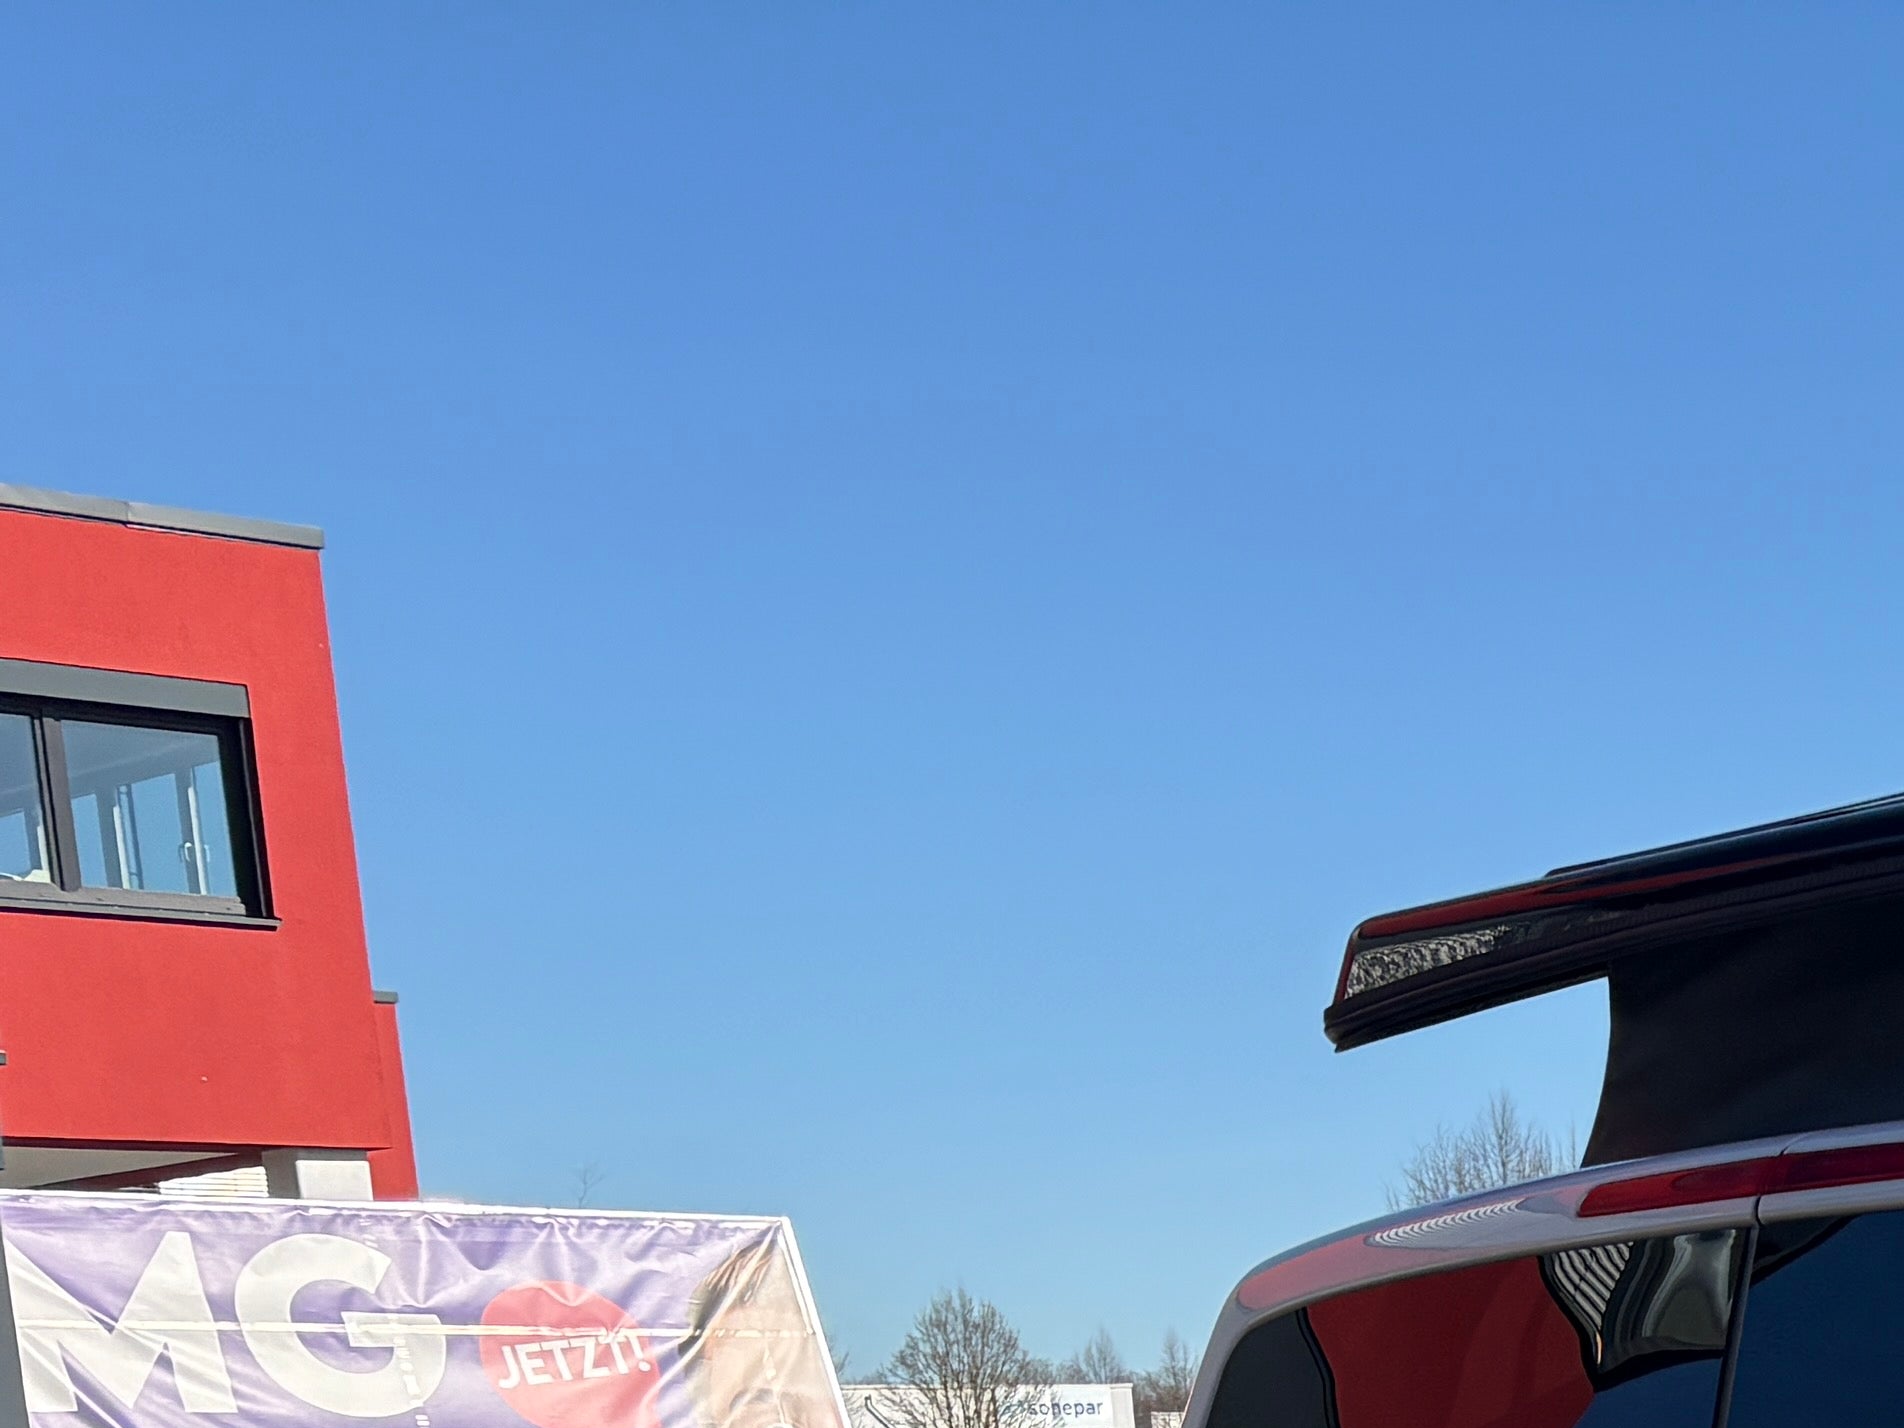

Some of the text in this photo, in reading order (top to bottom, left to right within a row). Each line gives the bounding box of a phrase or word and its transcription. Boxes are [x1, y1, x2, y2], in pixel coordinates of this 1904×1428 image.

[3, 1231, 446, 1416] MG
[499, 1336, 651, 1389] JETZT!
[1028, 1401, 1103, 1418] sonepar
